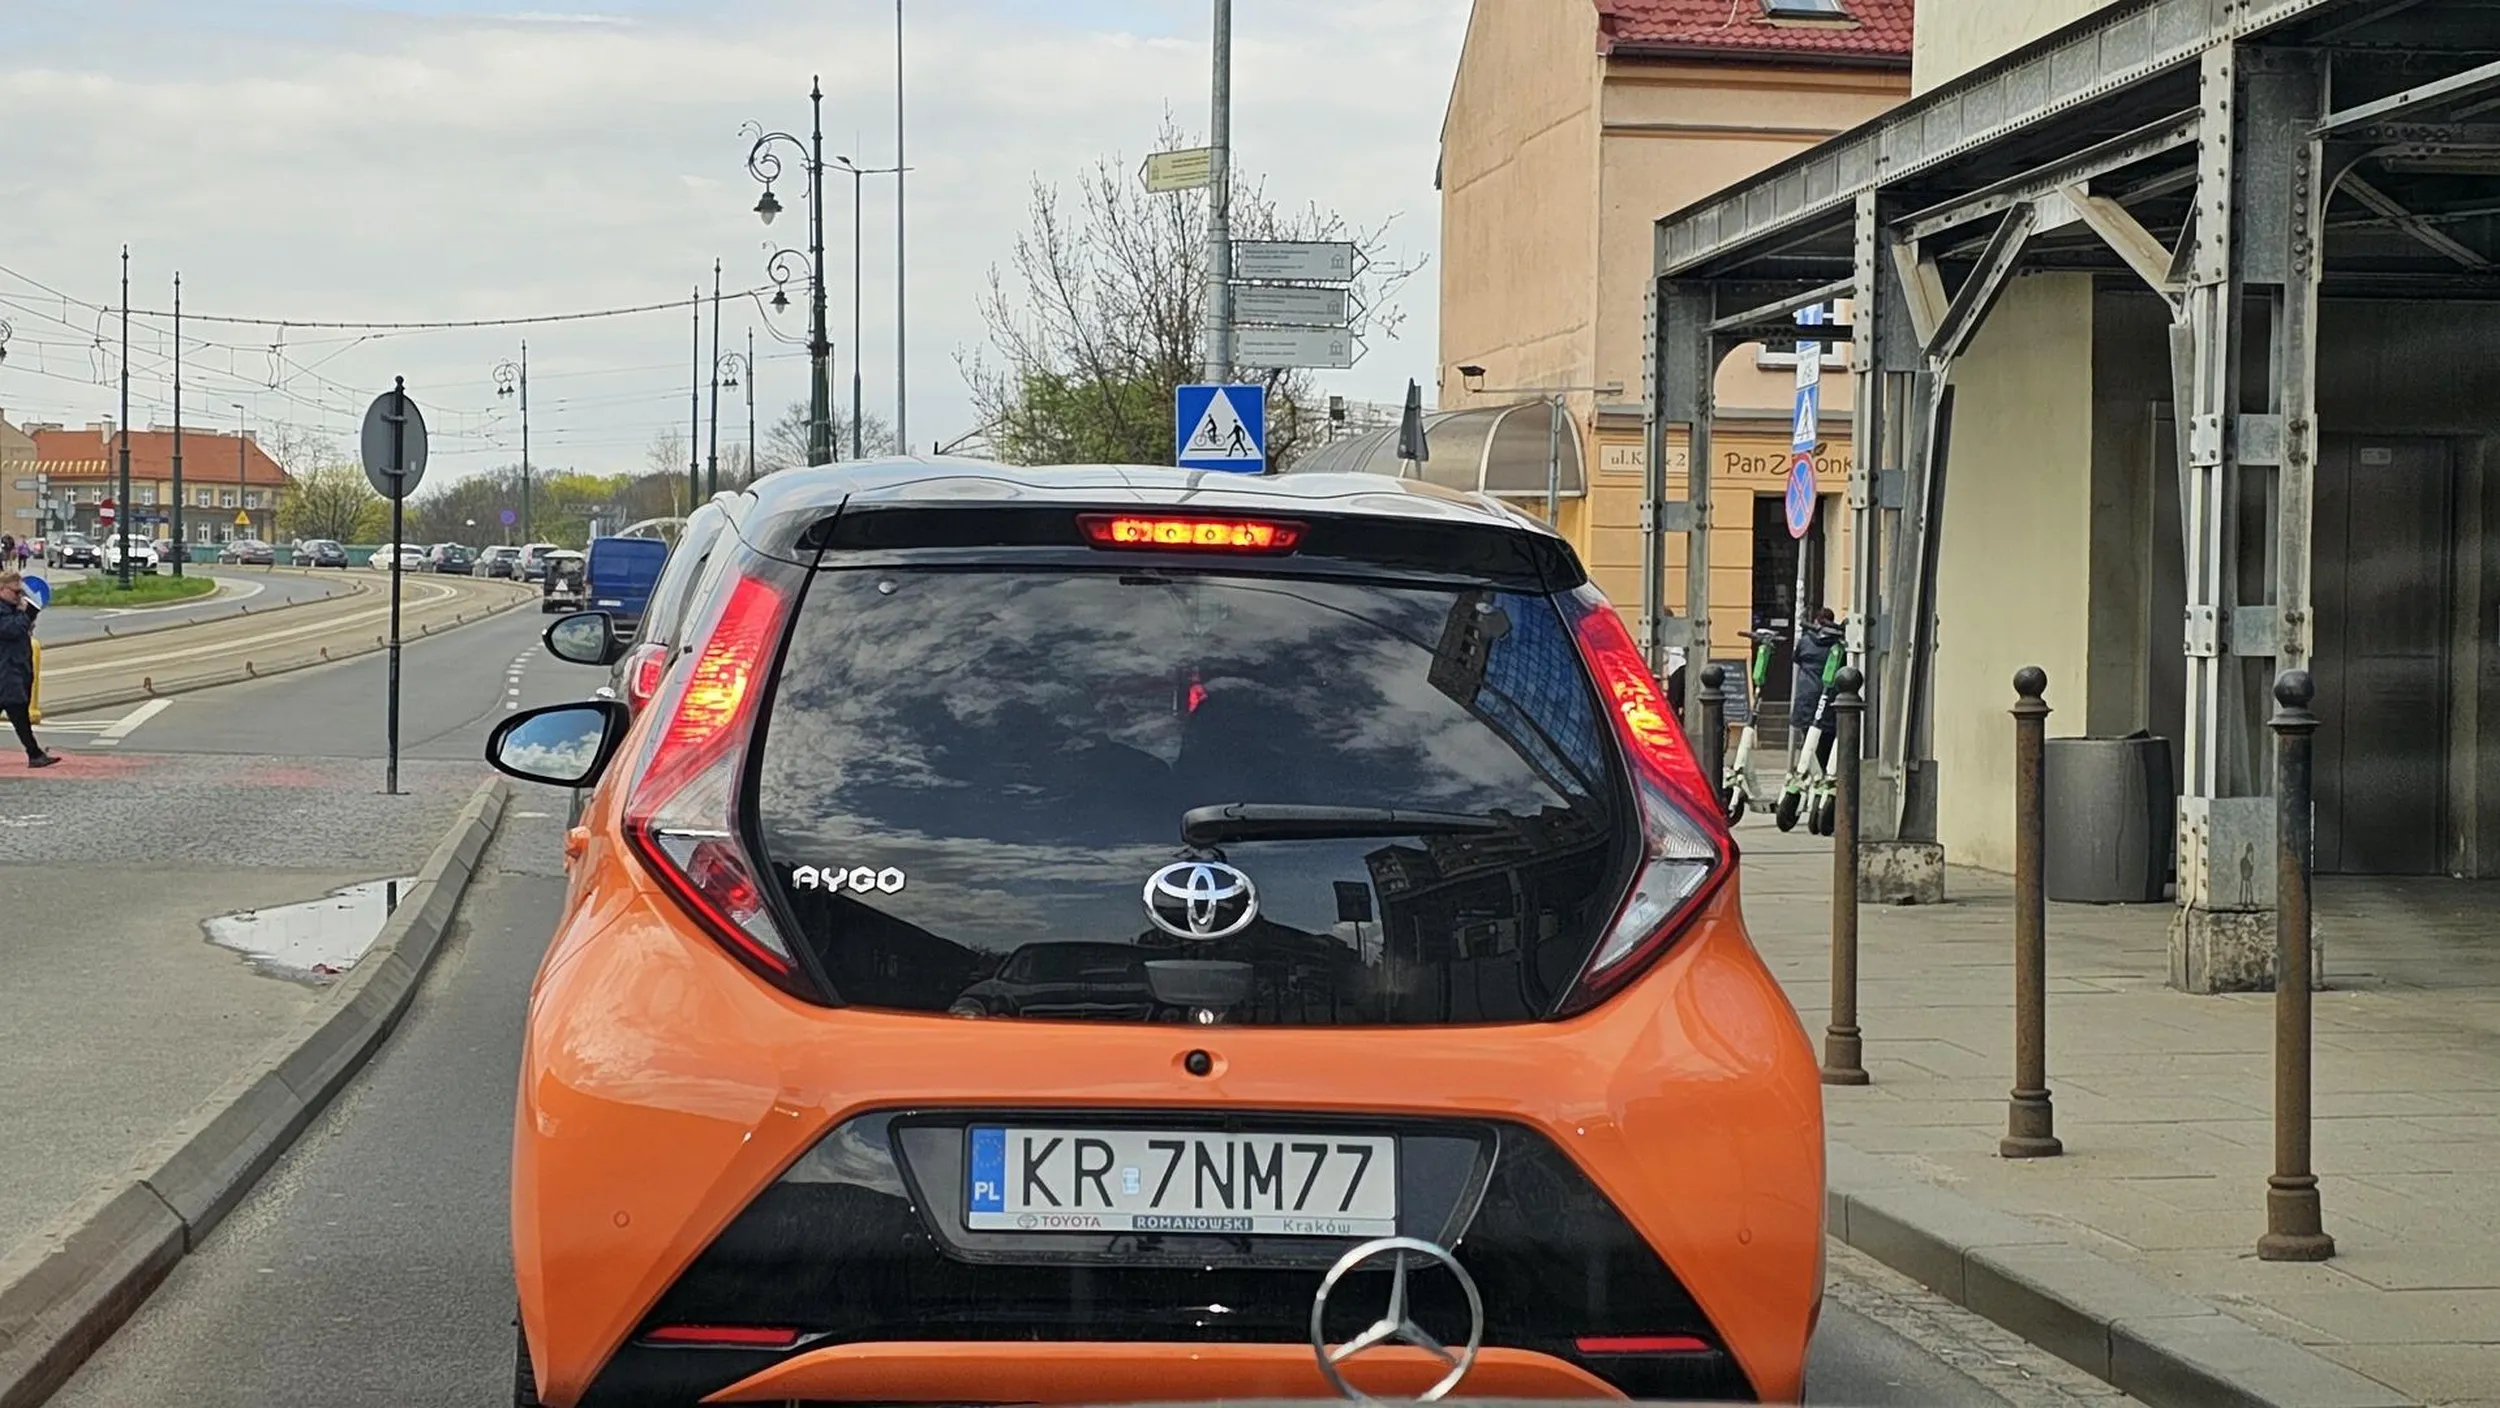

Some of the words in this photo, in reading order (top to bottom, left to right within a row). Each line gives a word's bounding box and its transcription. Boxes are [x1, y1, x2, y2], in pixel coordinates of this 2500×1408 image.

[1676, 453, 1686, 466] 2
[792, 865, 906, 894] AYGO
[1022, 1136, 1115, 1207] KR
[1148, 1140, 1373, 1212] 7NM77
[974, 1183, 1000, 1200] PL
[1041, 1215, 1101, 1228] TOYOTA
[1137, 1216, 1249, 1230] ROMANOWSKI
[1283, 1219, 1351, 1233] Kraków
